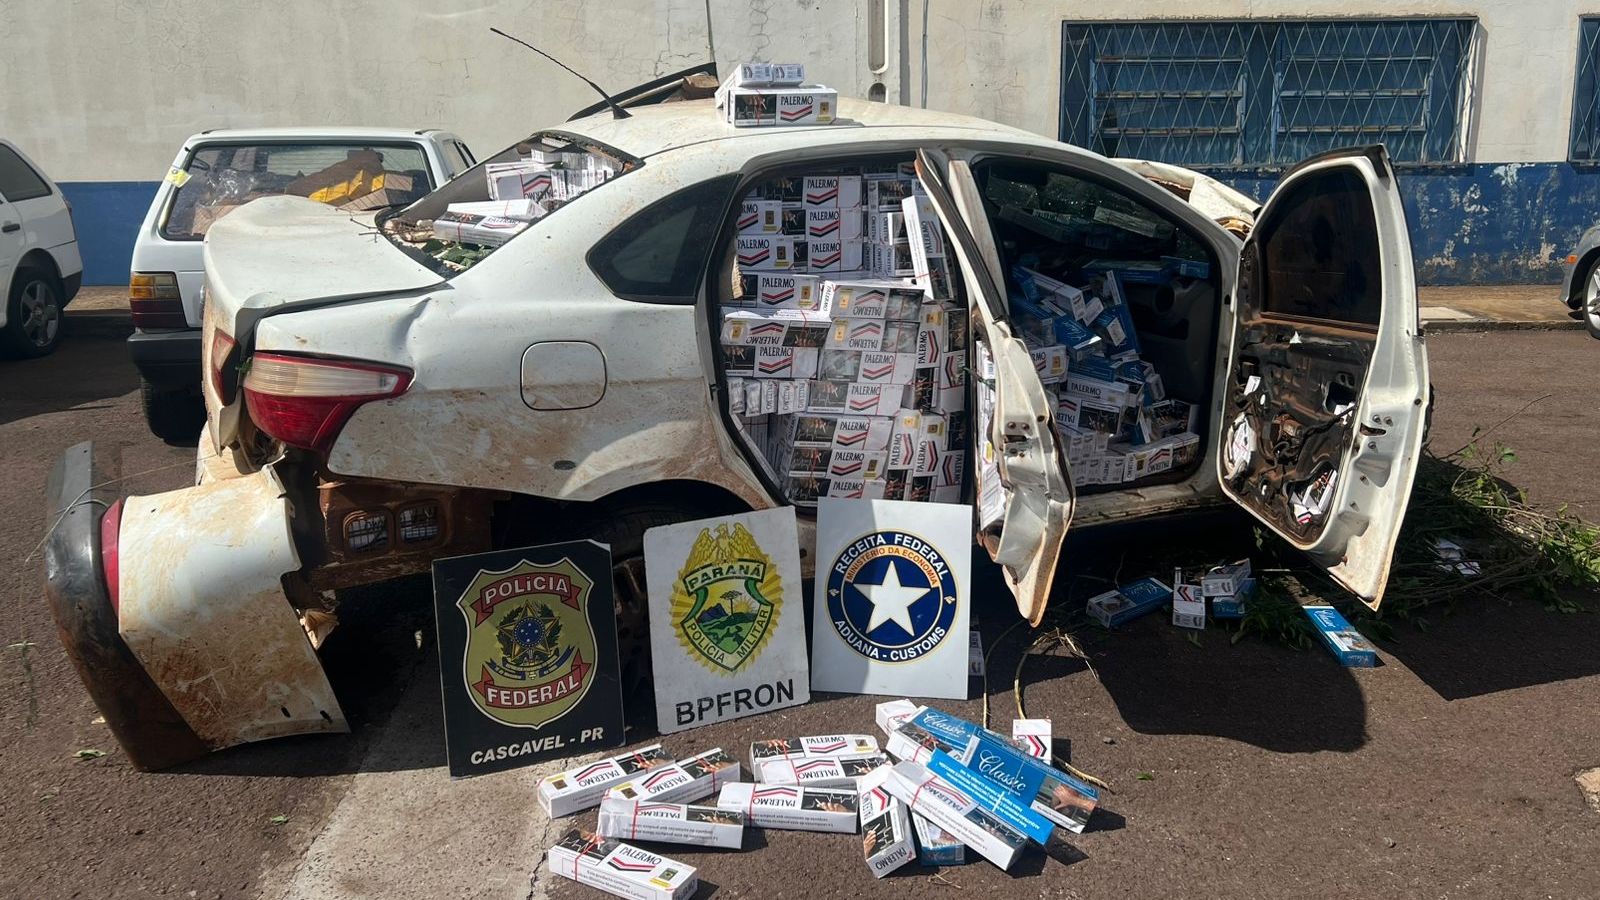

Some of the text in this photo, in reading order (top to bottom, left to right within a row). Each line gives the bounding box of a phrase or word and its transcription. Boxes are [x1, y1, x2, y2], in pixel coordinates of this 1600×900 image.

[780, 95, 814, 106] PALERMO
[807, 179, 838, 189] PALERMO
[809, 210, 839, 220] PALERMO
[920, 220, 934, 254] PALERMO
[737, 239, 770, 249] PALERMO
[812, 242, 841, 252] PALERMO
[762, 277, 795, 288] PALERMO
[853, 305, 883, 316] PALERMO
[746, 336, 780, 345] PALERMO
[849, 338, 879, 349] PALERMO
[760, 346, 792, 357] PALERMO
[917, 330, 928, 364] PALERMO
[865, 354, 894, 364] PALERMO
[852, 385, 880, 396] PALERMO
[1071, 383, 1102, 396] PALERMO
[1056, 412, 1075, 424] PALER
[839, 421, 870, 431] PALERMO
[891, 433, 901, 466] PALERMO
[834, 452, 865, 462] PALERMO
[916, 440, 928, 473] PALERMO
[832, 481, 863, 491] PALERMO
[835, 534, 949, 580] RECEITA FEDERAL
[888, 547, 900, 555] DA
[902, 549, 938, 585] ECONOMIA
[689, 564, 762, 590] PARANÁ
[688, 609, 769, 663] POLICIA MILITAR
[835, 620, 879, 659] ADUANA
[890, 626, 946, 661] CUSTOMS
[487, 674, 579, 706] FEDERAL
[675, 678, 795, 726] BPFRON
[470, 734, 565, 764] CASCAVEL
[580, 726, 604, 742] PR
[806, 736, 846, 744] PALERMO
[797, 769, 840, 780] PALERMO
[979, 749, 1026, 792] Classic
[579, 769, 620, 787] PALERMO
[647, 775, 688, 793] PALERMO
[752, 797, 796, 807] PALERMO
[923, 784, 963, 812] PALERMO
[636, 810, 682, 819] PALERMO
[619, 847, 662, 865] PALERMO
[875, 847, 907, 870] PALERMO
